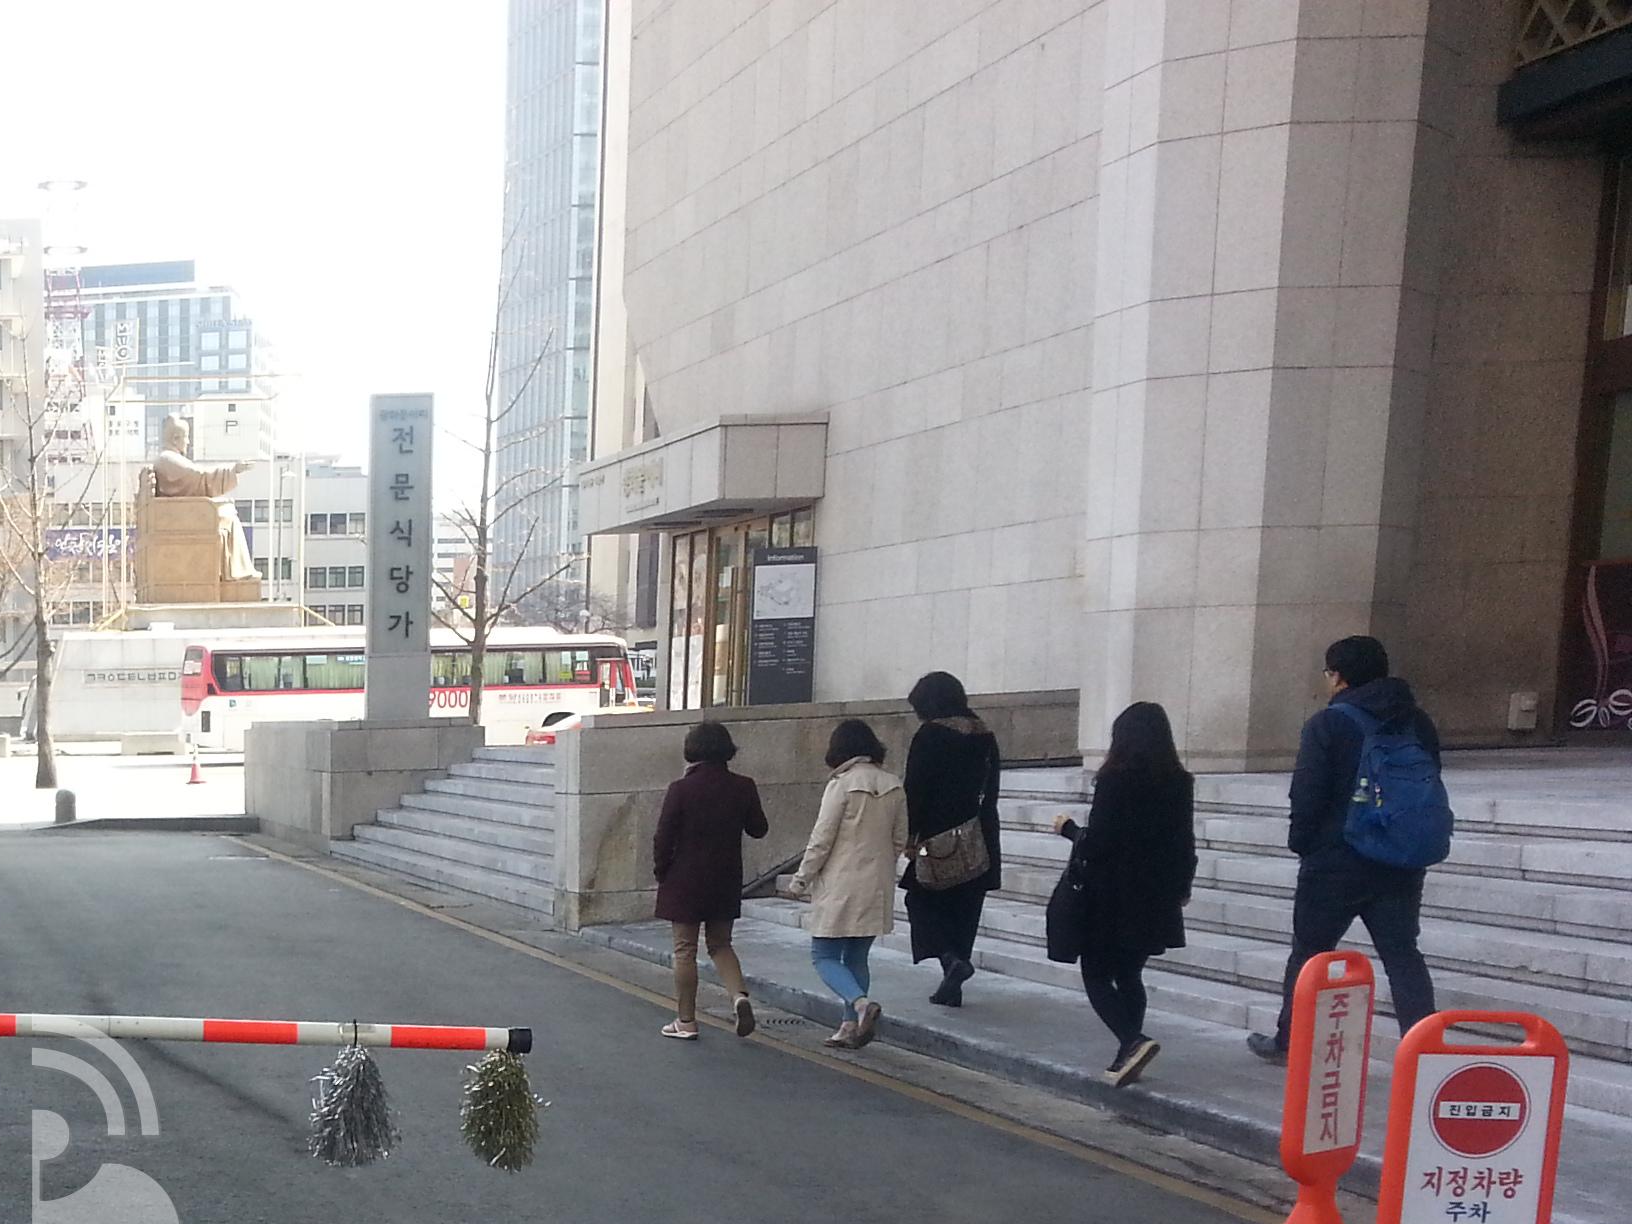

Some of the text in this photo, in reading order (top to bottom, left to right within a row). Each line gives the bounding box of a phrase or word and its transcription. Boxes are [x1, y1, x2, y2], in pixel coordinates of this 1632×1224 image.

[388, 425, 414, 638] 전문식당가
[1319, 993, 1350, 1145] 주차금지
[1449, 1105, 1511, 1117] 진입금지
[1420, 1166, 1524, 1199] 지정차량
[1445, 1201, 1492, 1224] 주차
